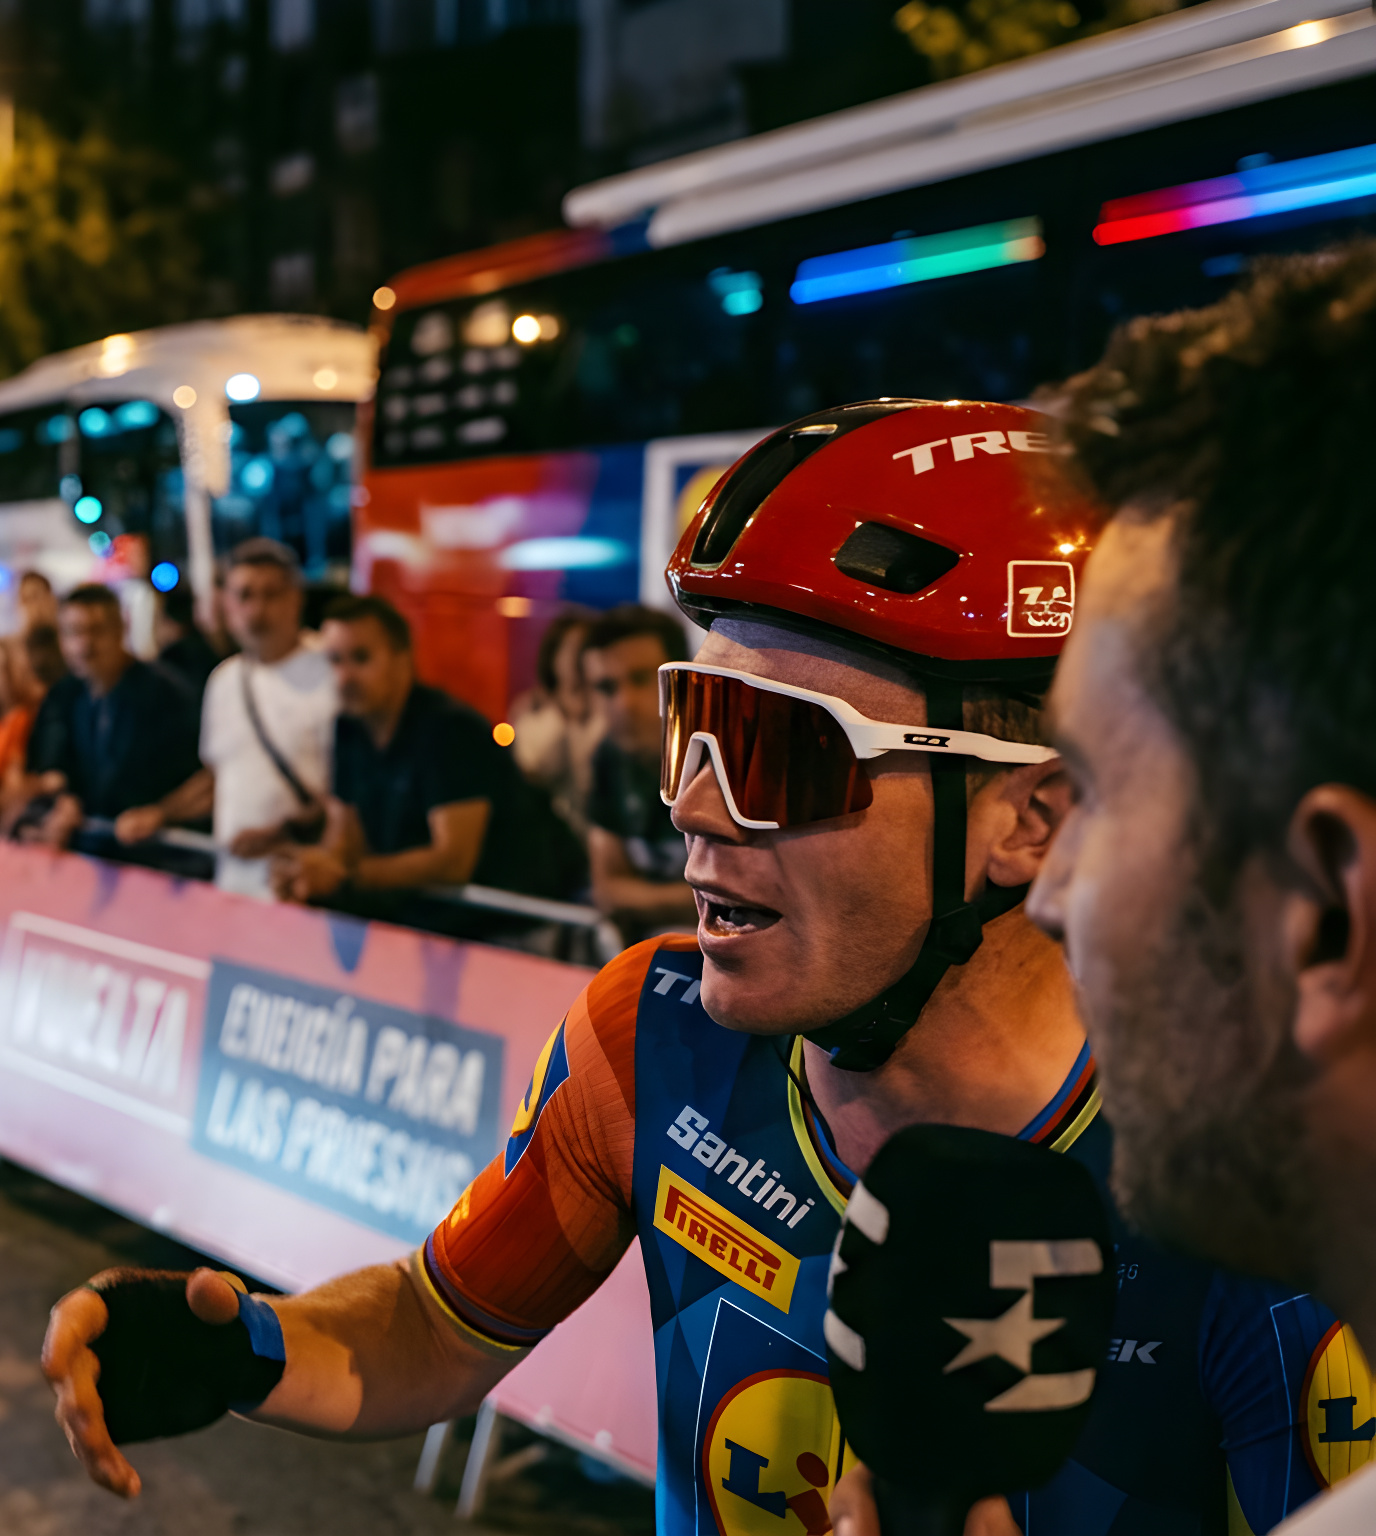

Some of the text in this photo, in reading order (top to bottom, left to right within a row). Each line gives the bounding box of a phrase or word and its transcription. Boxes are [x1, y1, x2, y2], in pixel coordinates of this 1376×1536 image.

[892, 430, 1070, 476] TRE
[205, 1069, 292, 1164] LAS
[364, 1025, 486, 1138] PARA
[666, 1104, 816, 1230] Santini
[663, 1184, 782, 1292] PIRELLI
